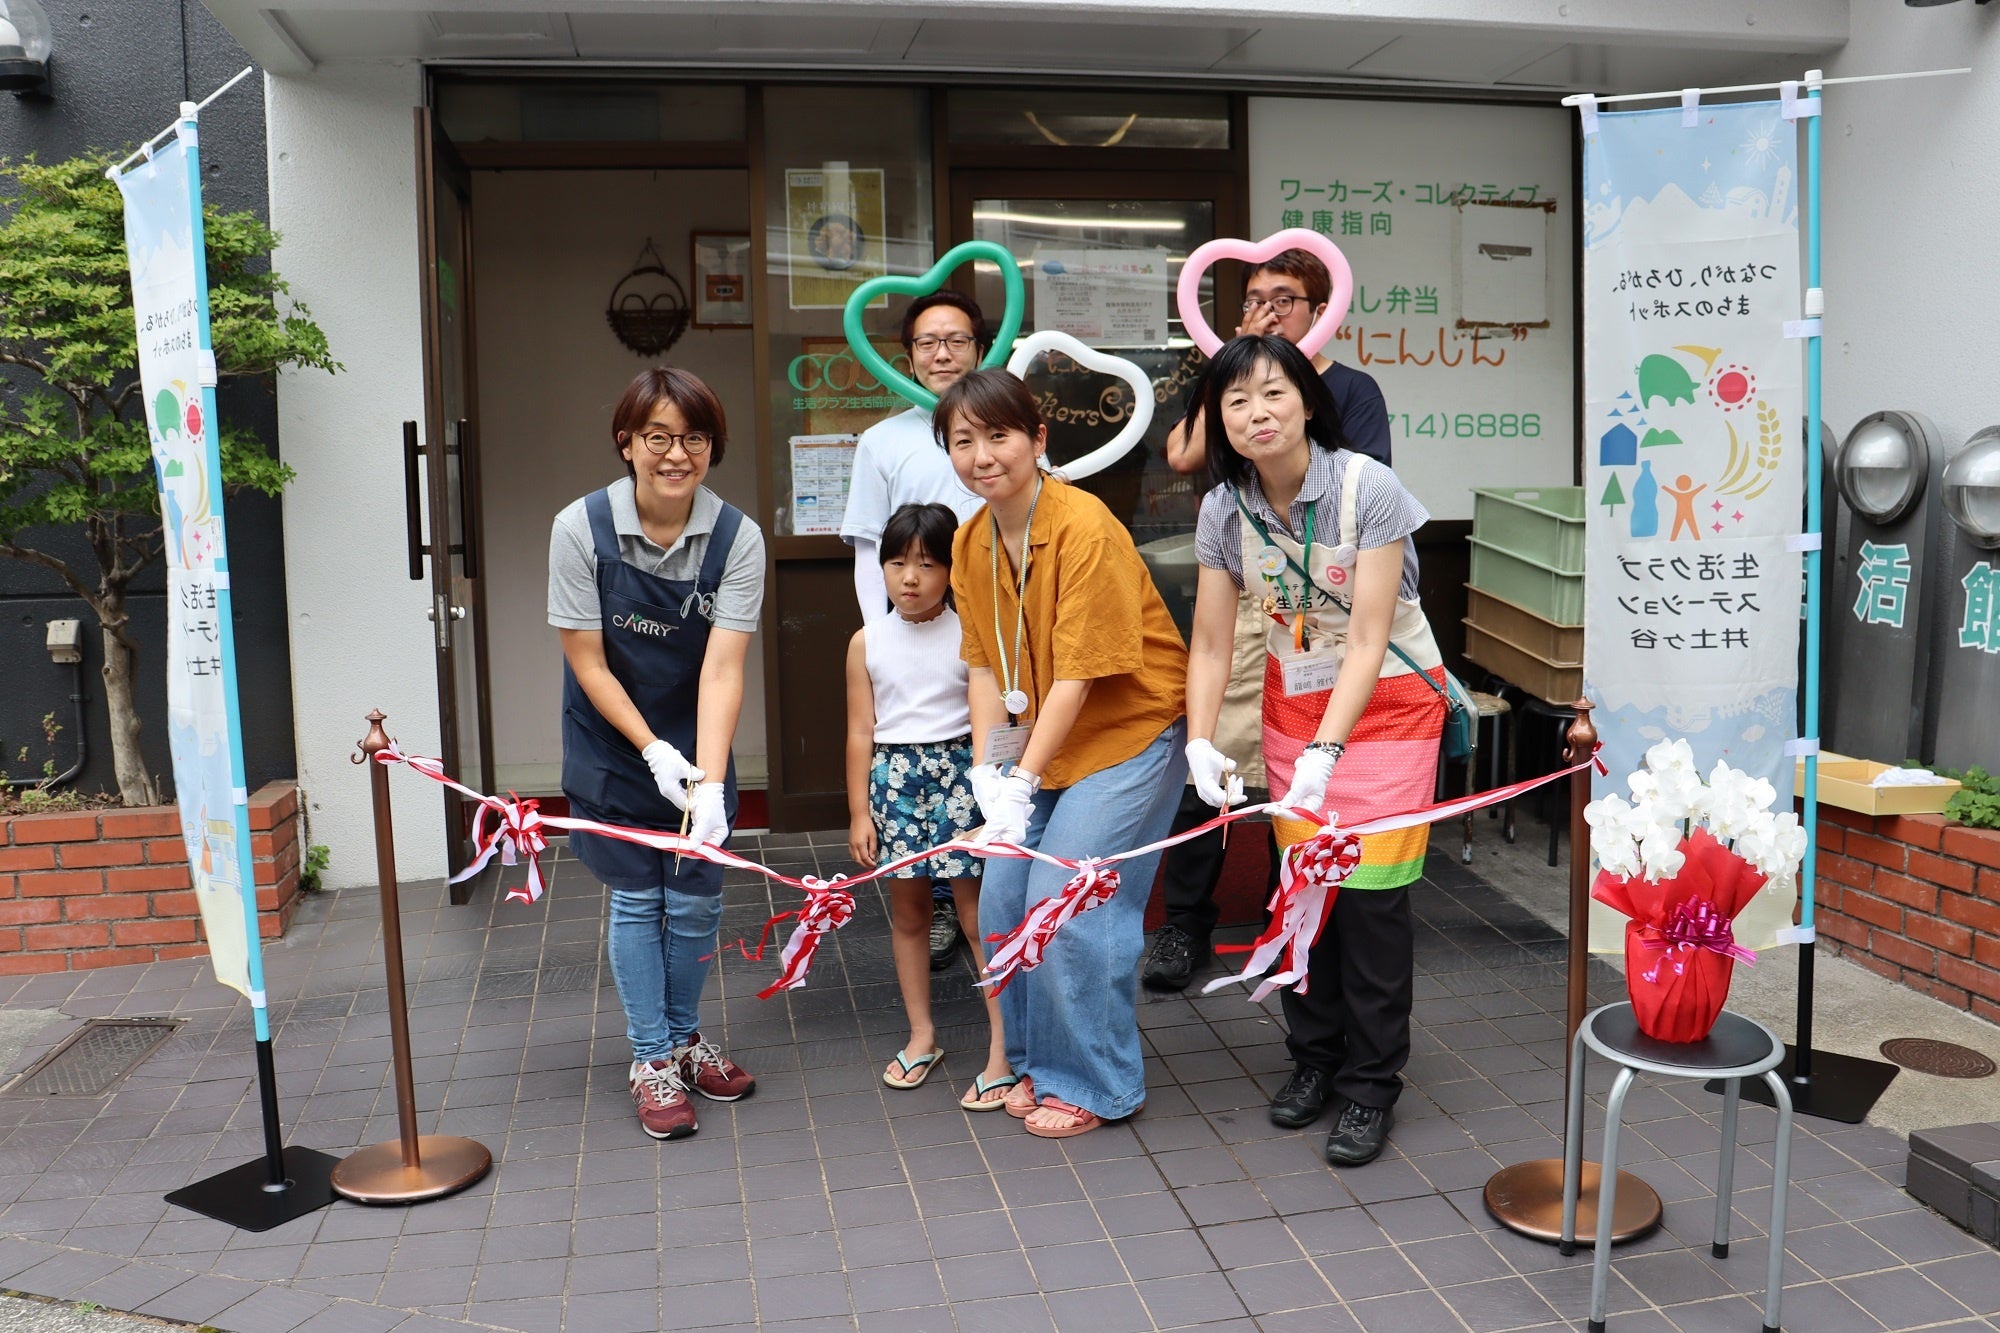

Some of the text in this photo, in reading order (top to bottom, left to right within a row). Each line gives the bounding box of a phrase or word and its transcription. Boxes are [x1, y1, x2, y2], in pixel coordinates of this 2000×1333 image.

[1280, 179, 1540, 208] ワーカーズ・コレクティブ
[1281, 209, 1393, 236] 健康指向
[1347, 284, 1439, 315] し弁当
[612, 613, 672, 637] CARRY
